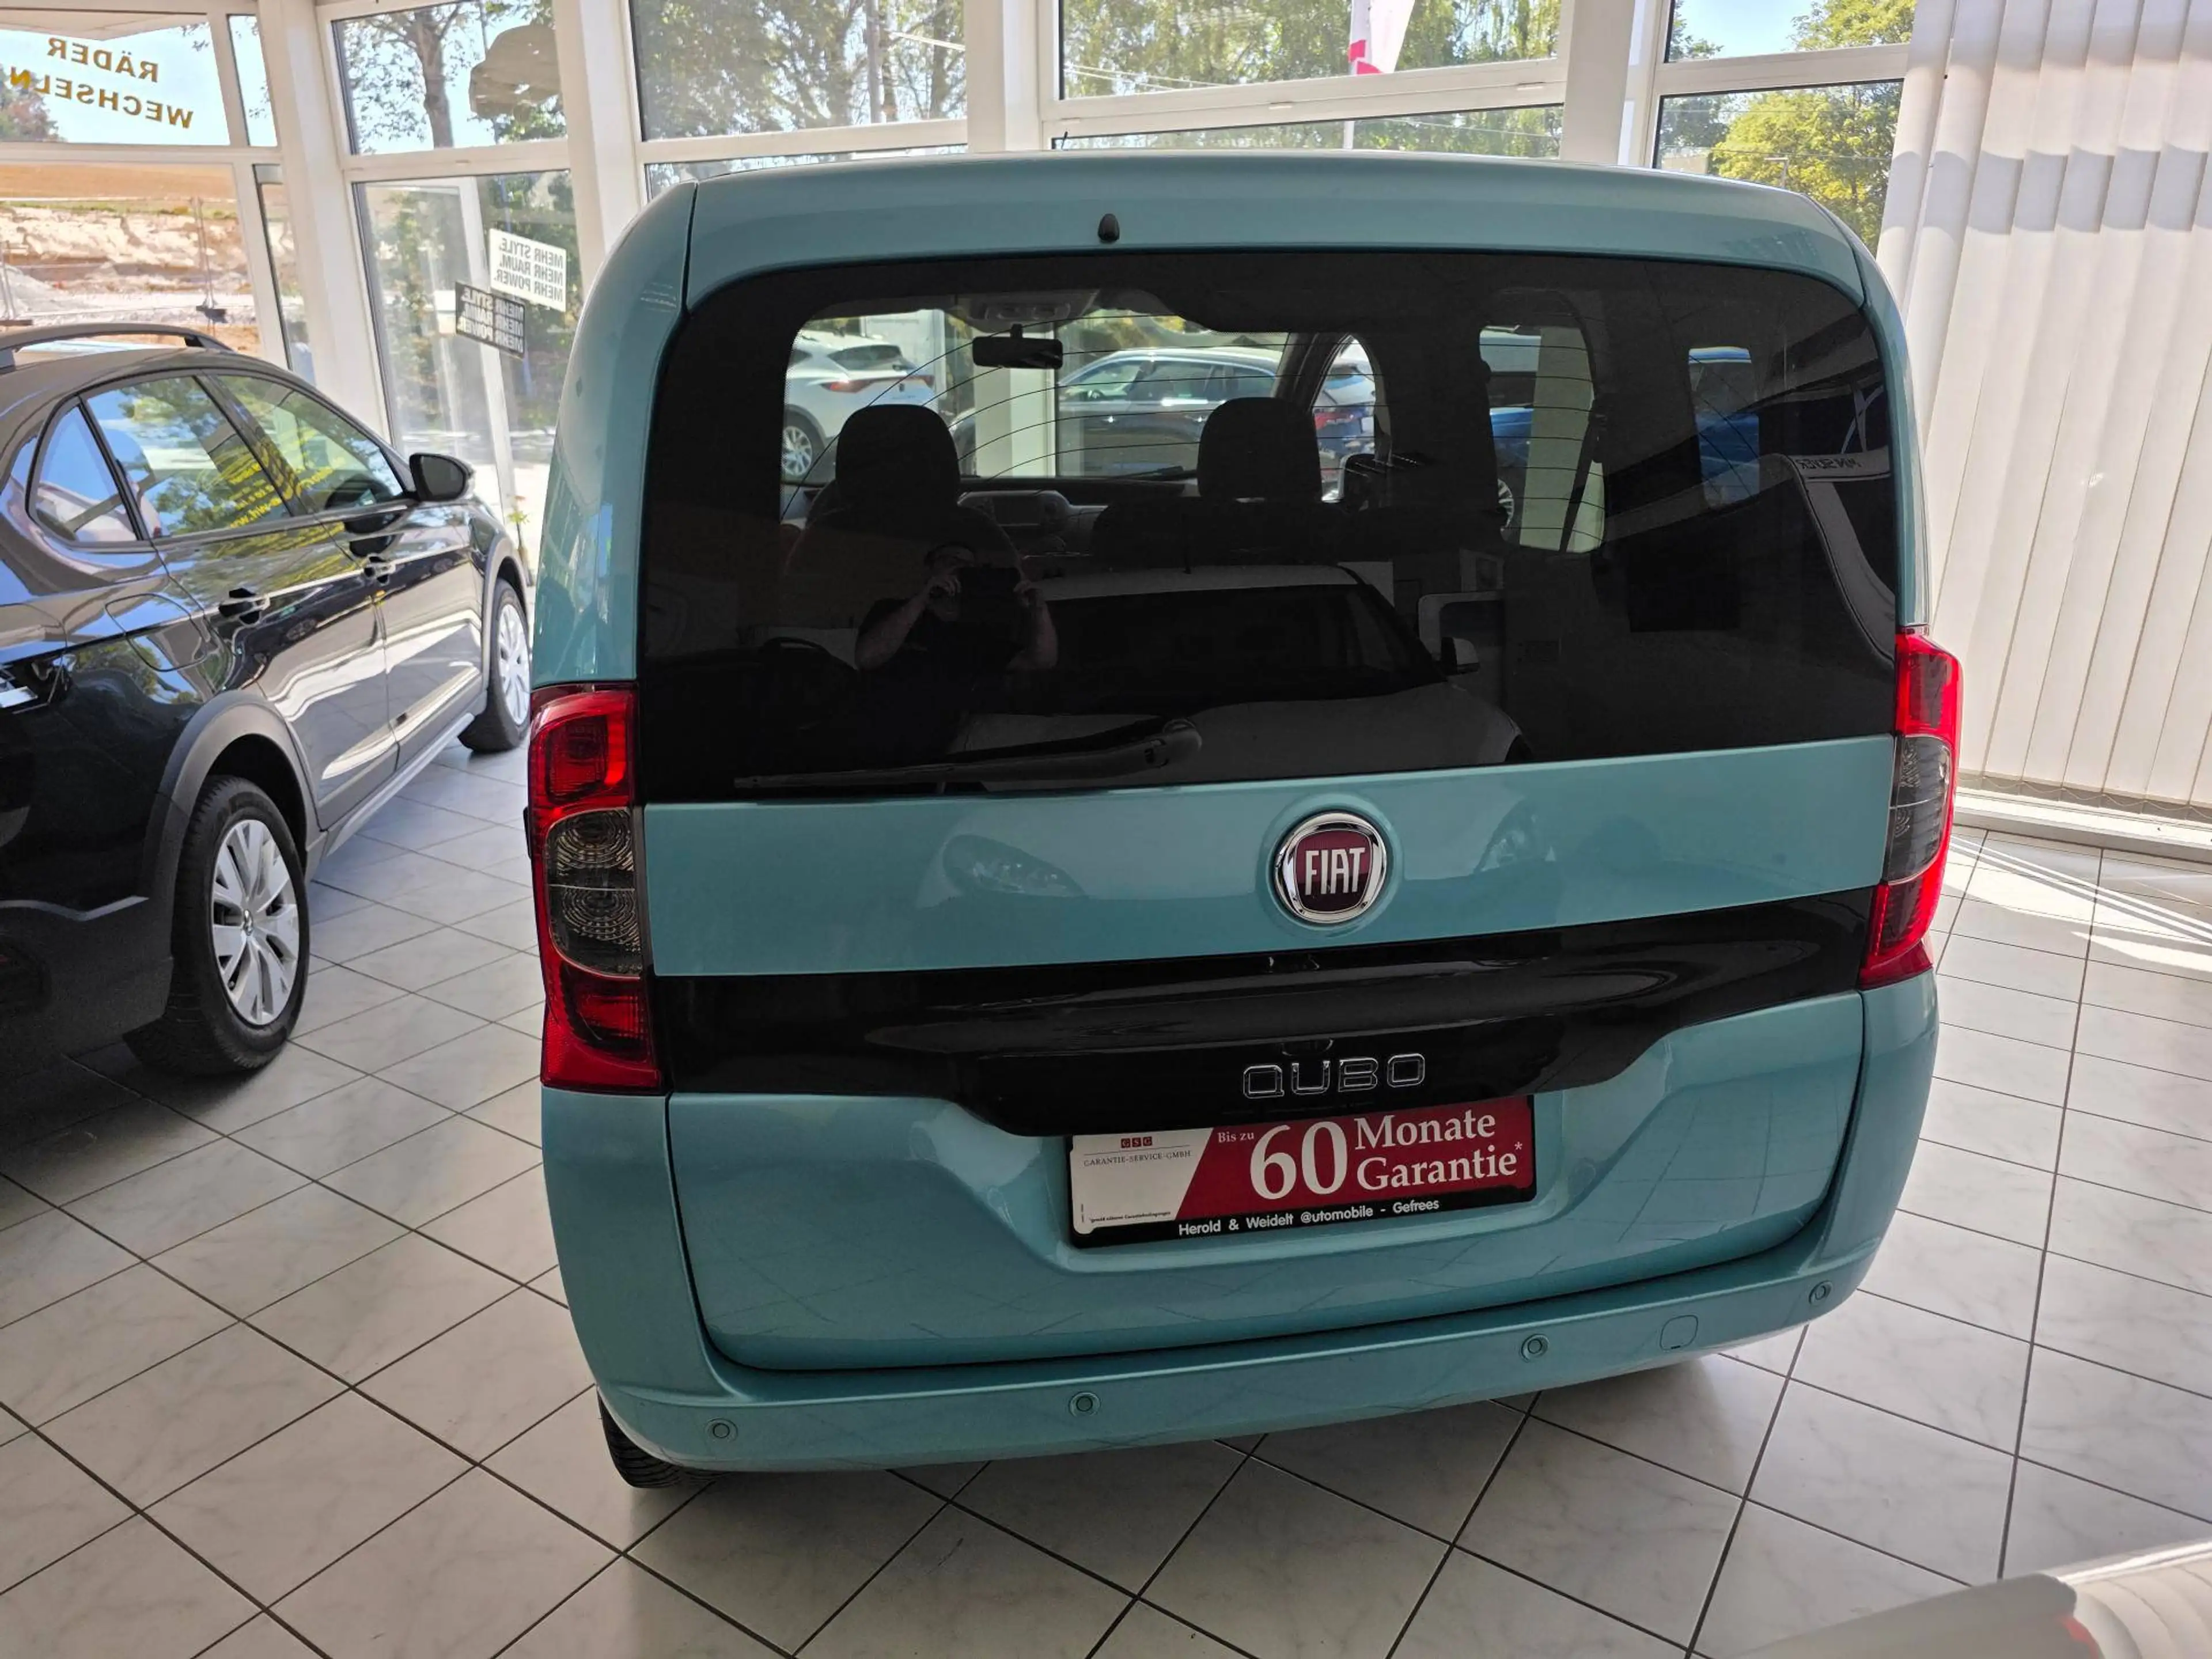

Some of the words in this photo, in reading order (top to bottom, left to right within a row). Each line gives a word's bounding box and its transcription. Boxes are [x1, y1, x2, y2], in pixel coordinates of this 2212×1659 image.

[1304, 847, 1366, 896] FIAT
[1243, 1052, 1425, 1099] QUBO
[1217, 1131, 1237, 1143] Bis
[1240, 1131, 1255, 1142] zu
[1249, 1120, 1349, 1200] 60
[1354, 1109, 1497, 1150] Monate
[1179, 1218, 1222, 1236] Herold
[1228, 1218, 1239, 1231] &
[1246, 1213, 1294, 1230] Weidelt
[1300, 1205, 1373, 1224] @utomobile
[1392, 1198, 1440, 1214] Gefrees
